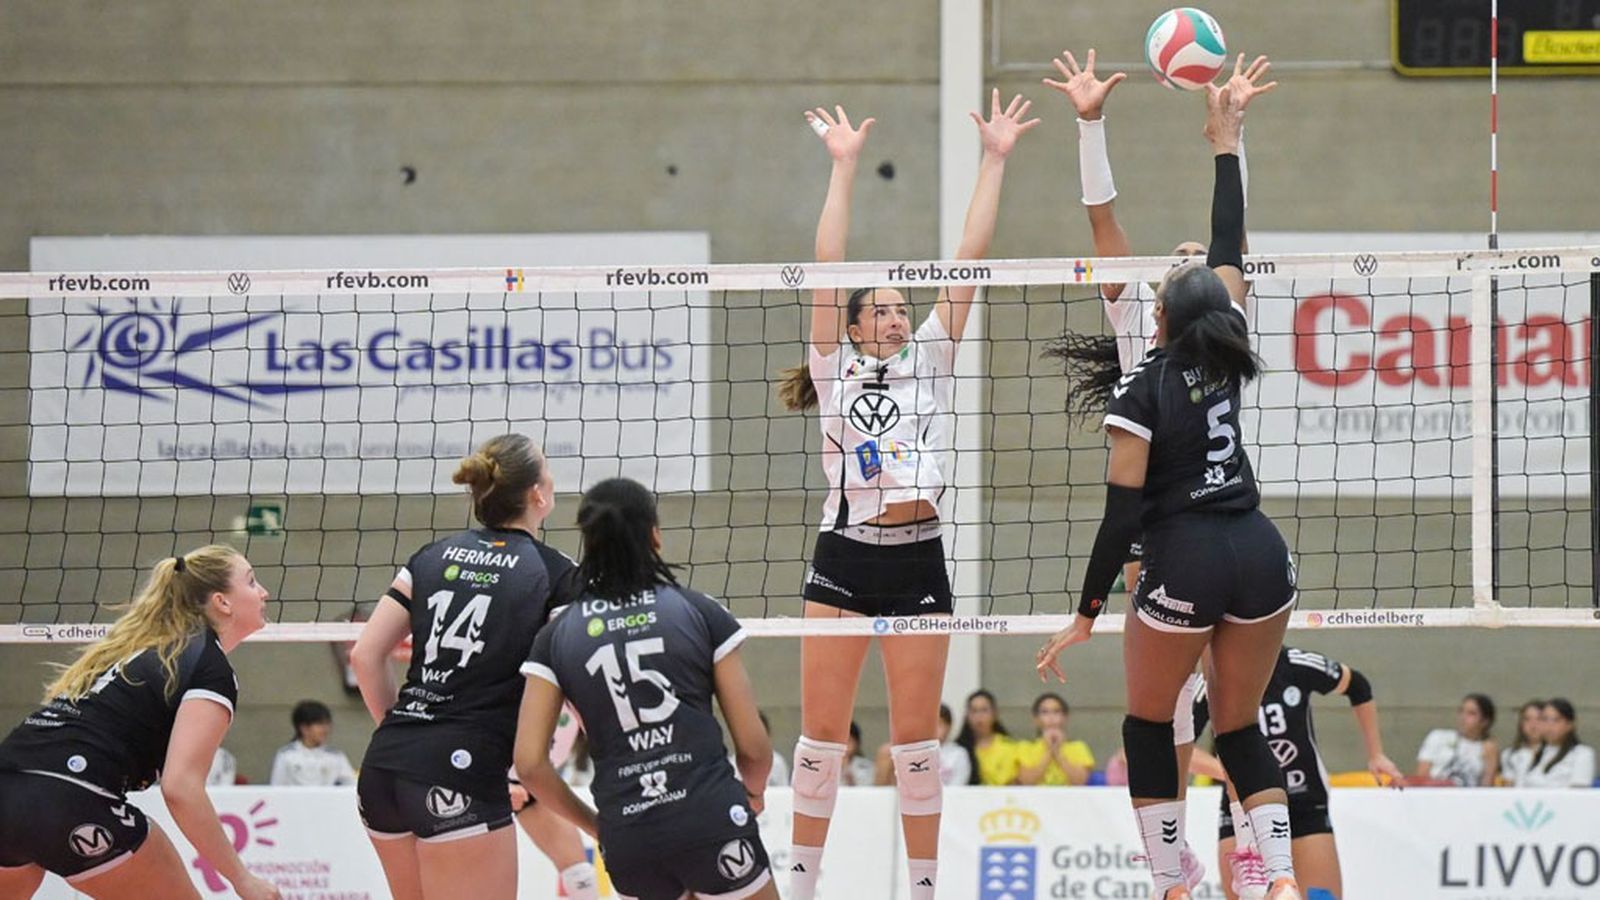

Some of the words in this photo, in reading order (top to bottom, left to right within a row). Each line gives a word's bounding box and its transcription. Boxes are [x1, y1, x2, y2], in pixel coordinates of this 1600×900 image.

[888, 262, 992, 281] rfevb.com
[1457, 253, 1561, 270] r.com
[49, 273, 150, 291] rfevb.com
[326, 271, 429, 289] rfevb.com
[606, 268, 709, 286] rfevb.com
[265, 331, 353, 372] Las
[367, 326, 574, 371] Casillas
[588, 327, 673, 371] Bus
[1293, 292, 1591, 388] Cana
[1206, 399, 1236, 461] 5
[442, 546, 519, 569] HERMAN
[459, 570, 500, 583] ERGOS
[424, 589, 492, 668] 14
[607, 611, 657, 632] ERGOS
[893, 619, 1008, 632] @CBHeidelberg
[1327, 611, 1424, 625] cdheidelberg
[585, 637, 680, 732] 15
[628, 724, 674, 751] WAY
[1052, 846, 1151, 869] Gobie
[1441, 844, 1600, 887] LIVVO
[1051, 875, 1087, 898] de
